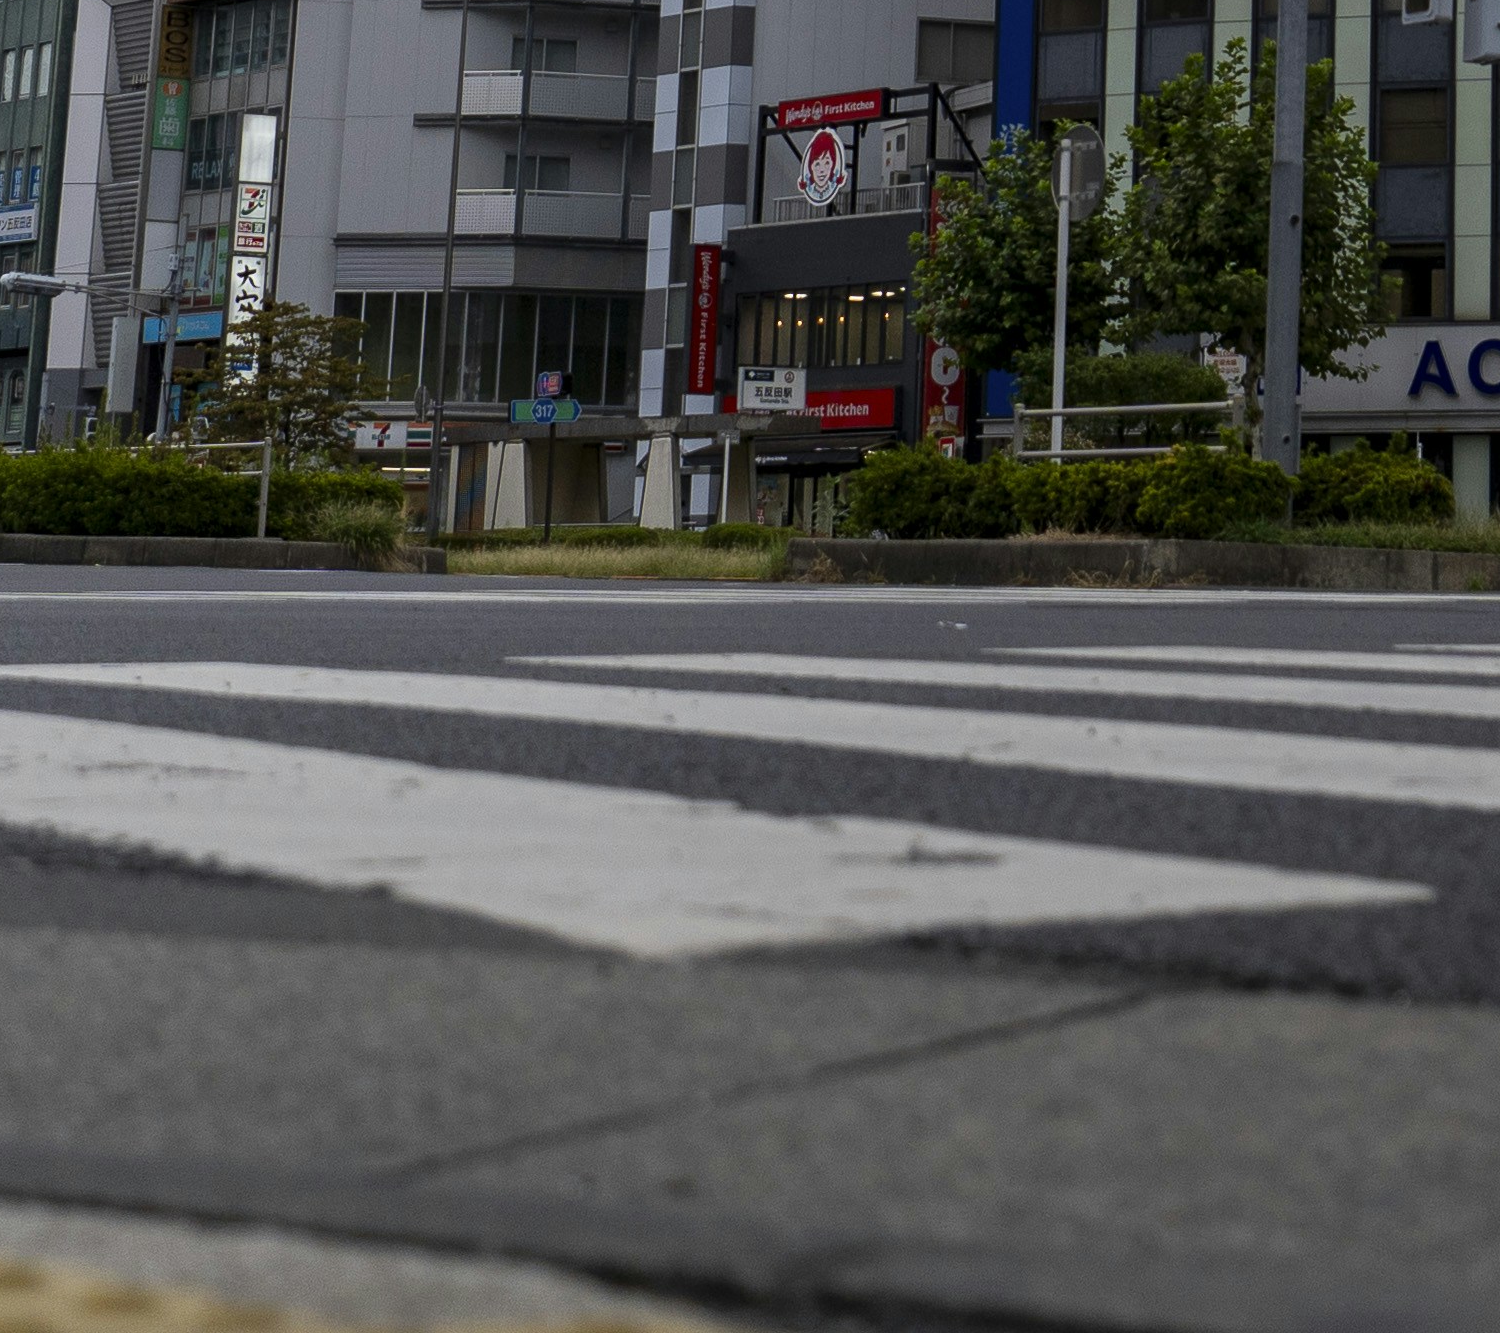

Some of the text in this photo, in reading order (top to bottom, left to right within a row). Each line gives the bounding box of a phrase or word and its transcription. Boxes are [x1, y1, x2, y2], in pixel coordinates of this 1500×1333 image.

[824, 104, 844, 115] First
[844, 100, 875, 112] Kitchen
[700, 311, 709, 339] First
[697, 341, 708, 388] Kitchen
[754, 386, 793, 398] 五反田駅
[535, 404, 554, 418] 317
[826, 402, 869, 417] Kitchen
